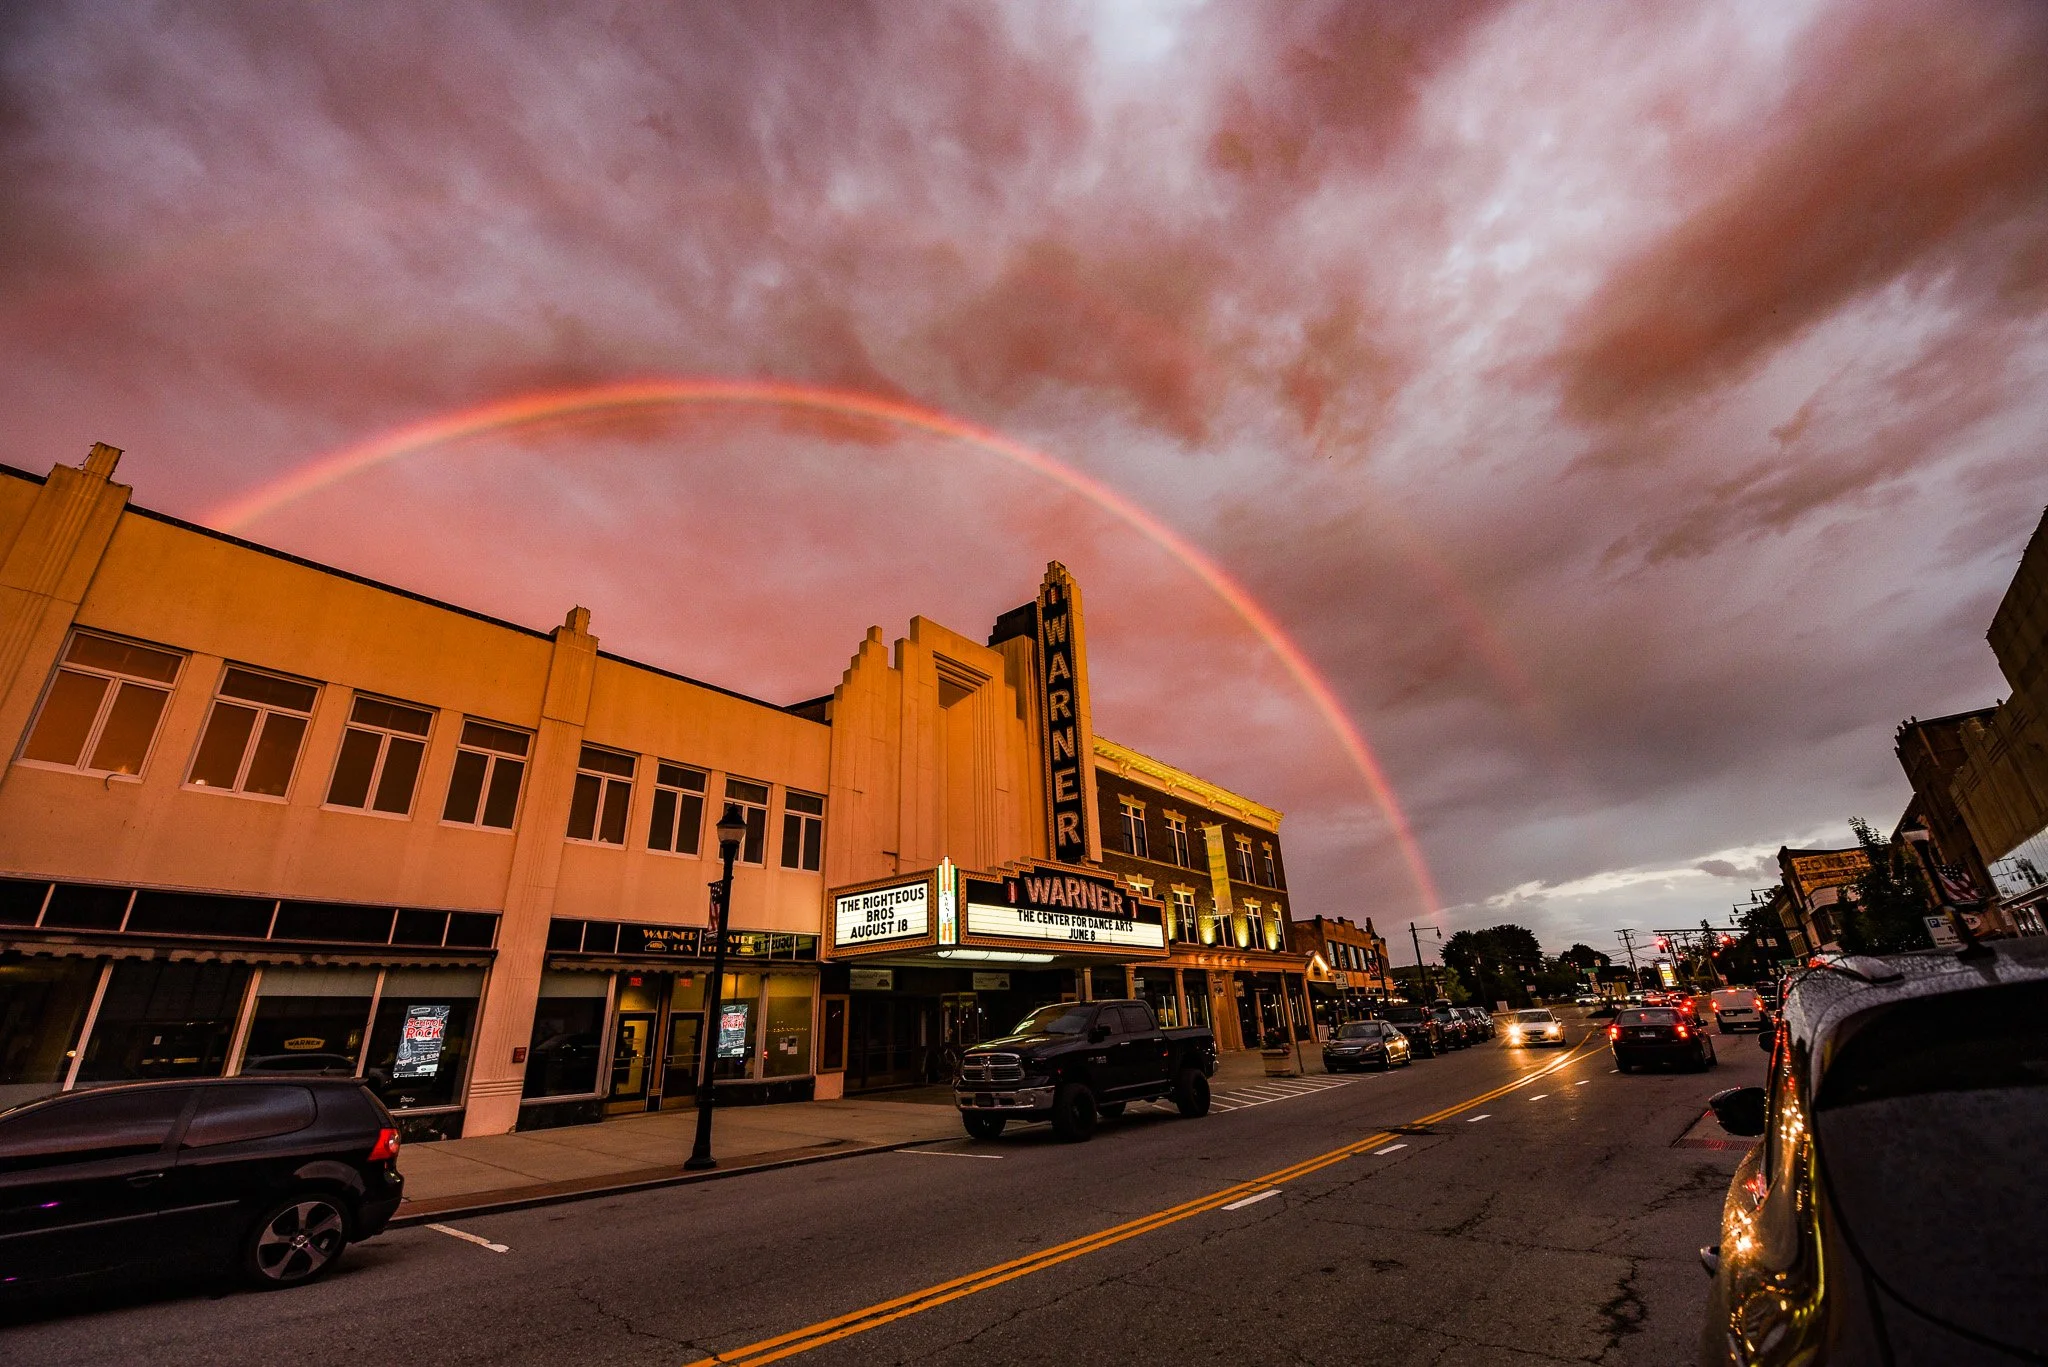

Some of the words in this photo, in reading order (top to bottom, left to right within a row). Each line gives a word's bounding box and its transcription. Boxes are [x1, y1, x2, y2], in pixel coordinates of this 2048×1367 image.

[1044, 613, 1082, 847] WARNER
[841, 899, 860, 913] THE
[863, 887, 924, 909] RIGHTEOUS
[1024, 877, 1124, 915] WARNER
[867, 906, 894, 922] BROS
[1017, 909, 1036, 922] THE
[1037, 912, 1070, 927] CENTER
[1071, 916, 1088, 928] FOR
[1088, 918, 1114, 931] DANCE
[1114, 921, 1133, 932] ARTS
[643, 929, 697, 941] WARNER
[850, 921, 894, 939] AUGUST
[897, 919, 908, 932] 18
[1068, 928, 1090, 941] JUNE
[1090, 930, 1096, 941] 8
[407, 1017, 444, 1027] SCHOOL
[406, 1027, 442, 1039] ROCK
